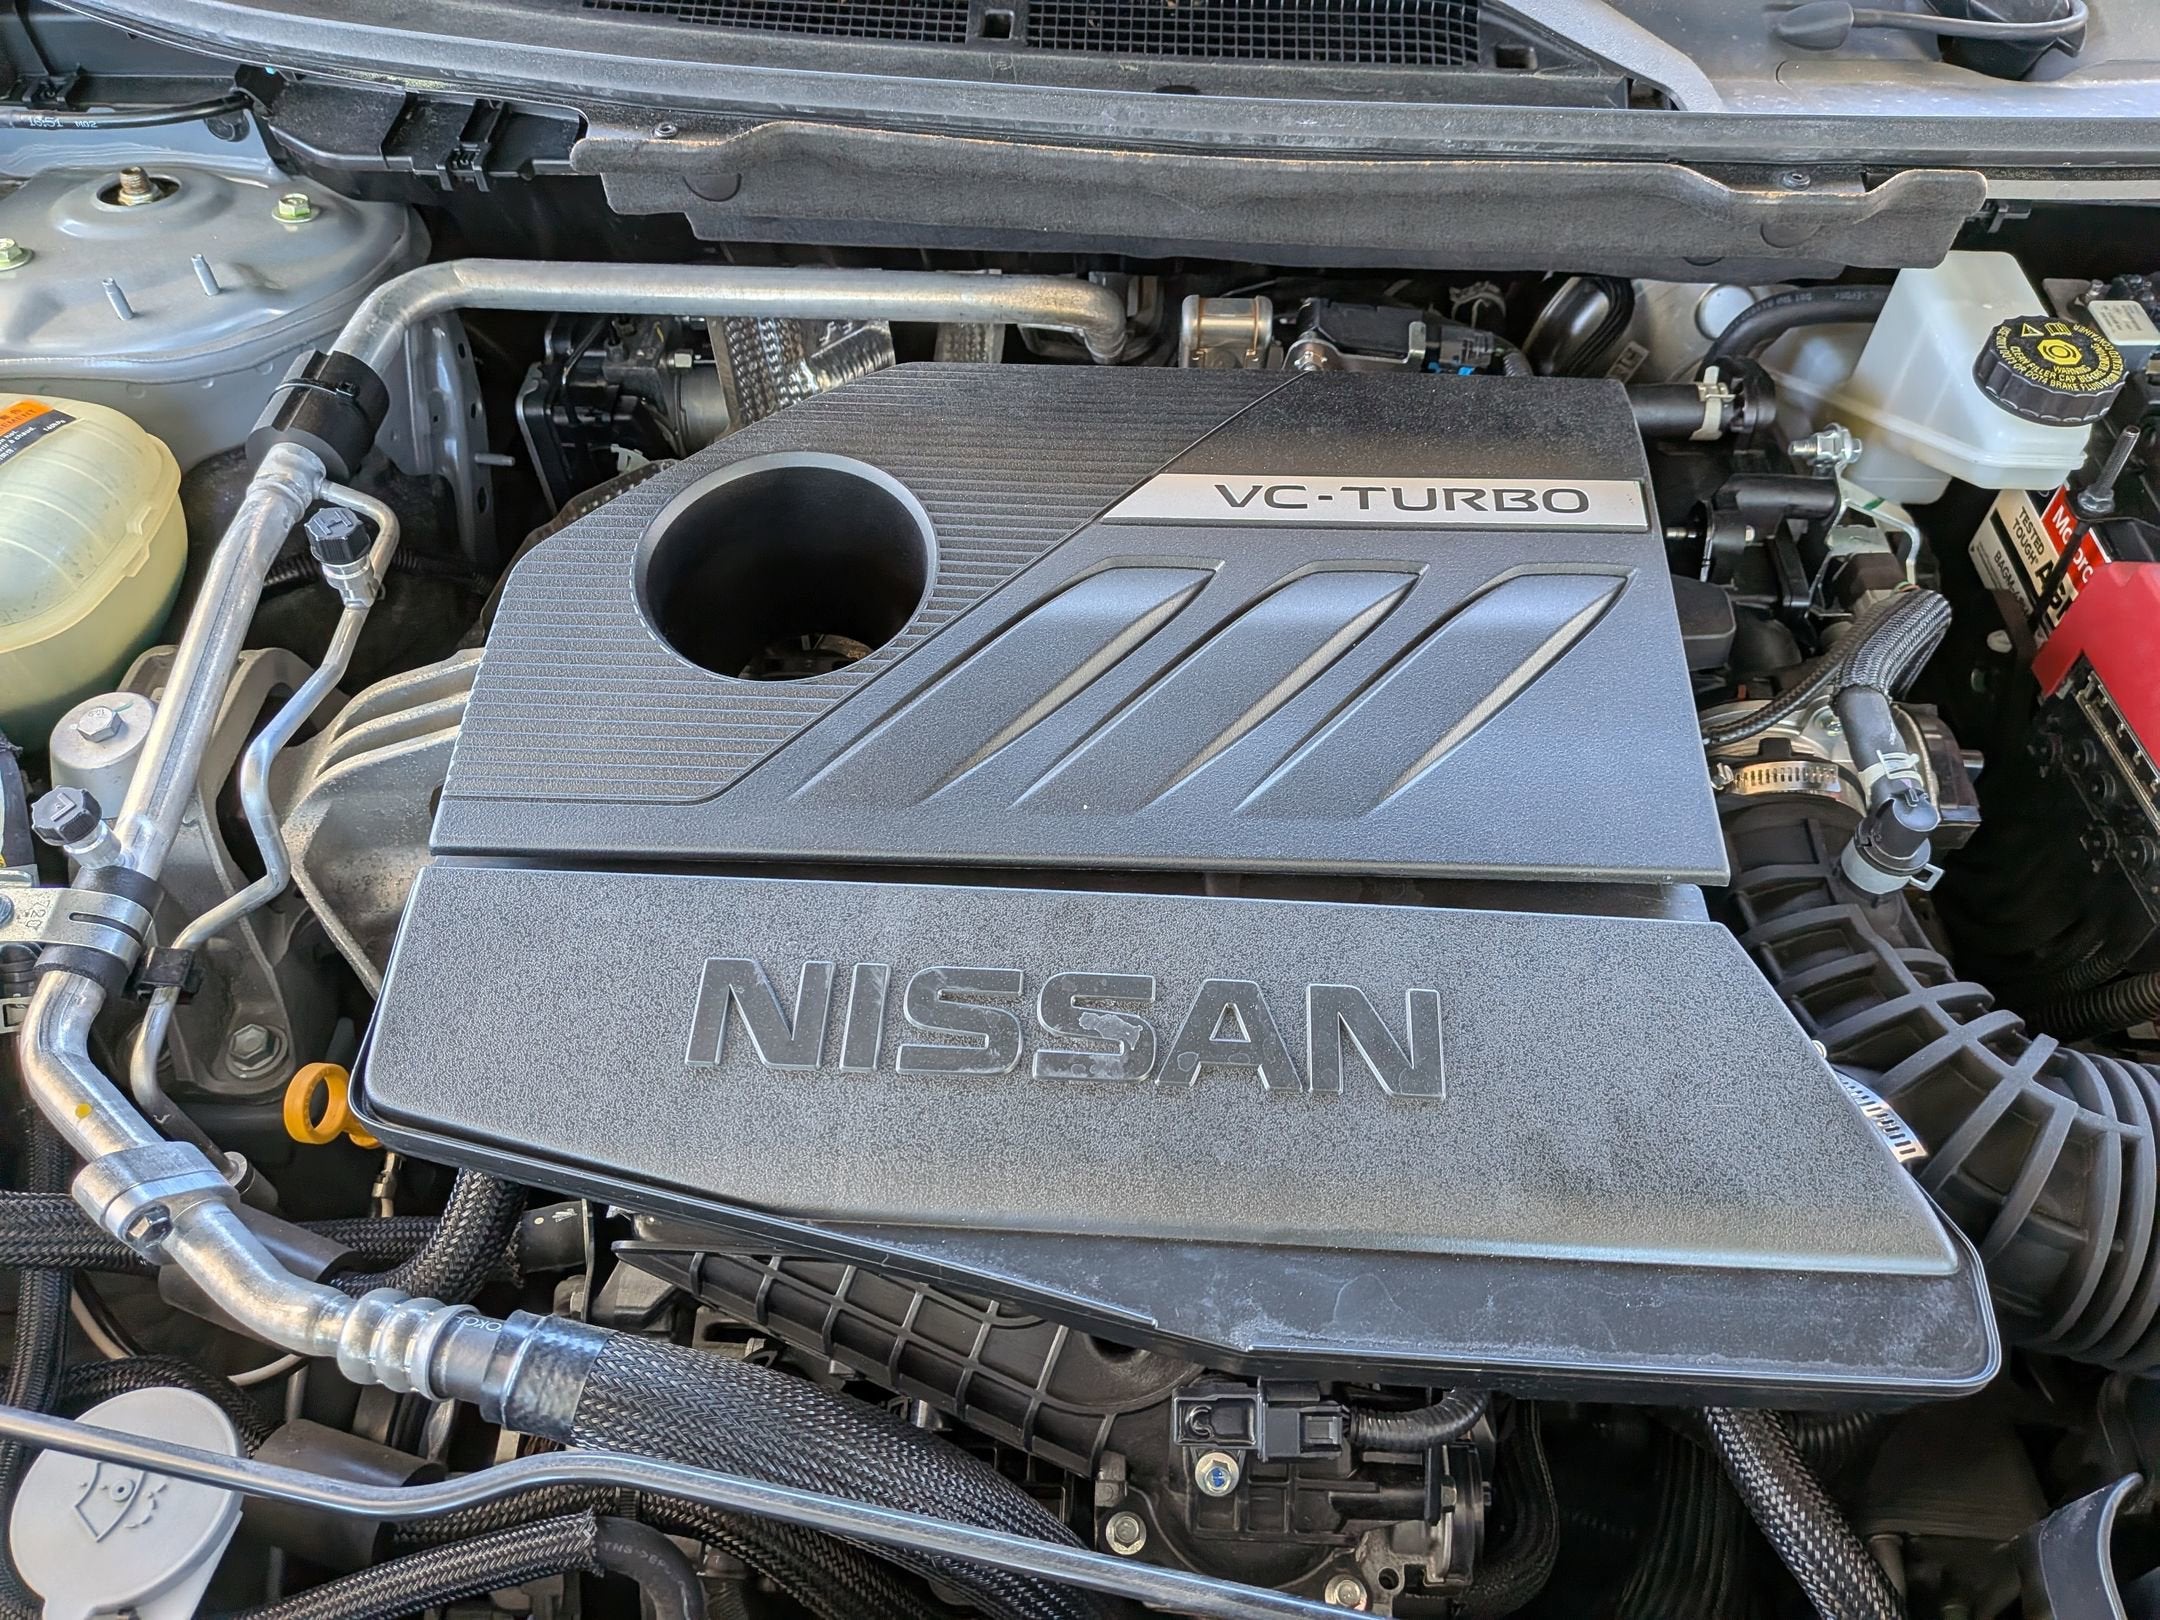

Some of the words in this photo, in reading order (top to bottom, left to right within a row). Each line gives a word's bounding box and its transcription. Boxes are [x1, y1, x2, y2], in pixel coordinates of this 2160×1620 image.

[2073, 324, 2113, 350] CONTAINER
[2012, 363, 2026, 373] OR
[2024, 370, 2048, 384] DOT4
[2026, 362, 2056, 379] FILLER
[2058, 374, 2076, 382] CAP
[2053, 365, 2091, 375] WARNING
[2049, 379, 2079, 391] BRAKE
[2079, 381, 2103, 391] FLUID
[1214, 484, 1590, 514] VC-TURBO
[314, 510, 353, 536] H
[2020, 506, 2045, 556] TESTED
[50, 792, 77, 822] L
[684, 957, 1446, 1101] NISSAN
